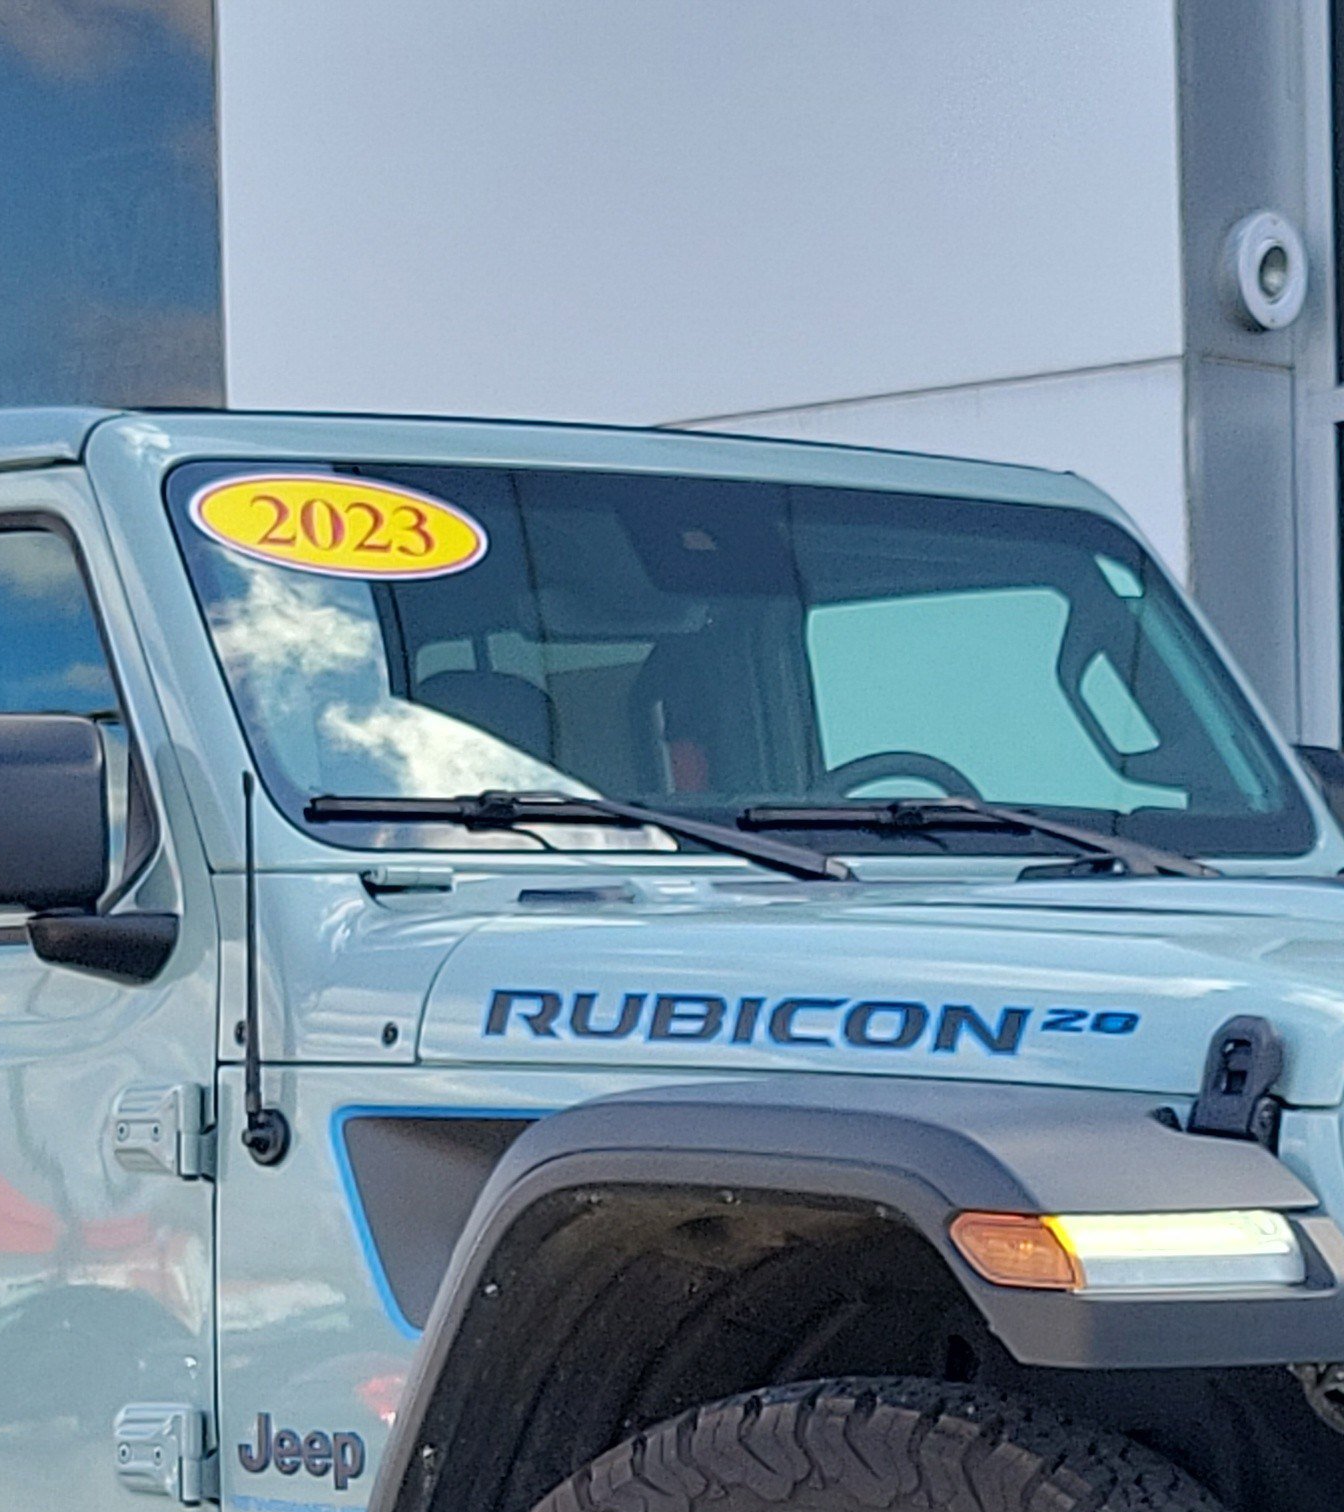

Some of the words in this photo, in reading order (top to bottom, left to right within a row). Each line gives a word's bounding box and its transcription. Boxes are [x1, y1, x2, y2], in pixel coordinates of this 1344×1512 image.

[250, 494, 436, 558] 2023
[483, 988, 1034, 1055] RUBICON
[1040, 1007, 1141, 1035] 20
[237, 1411, 366, 1491] Jeep
